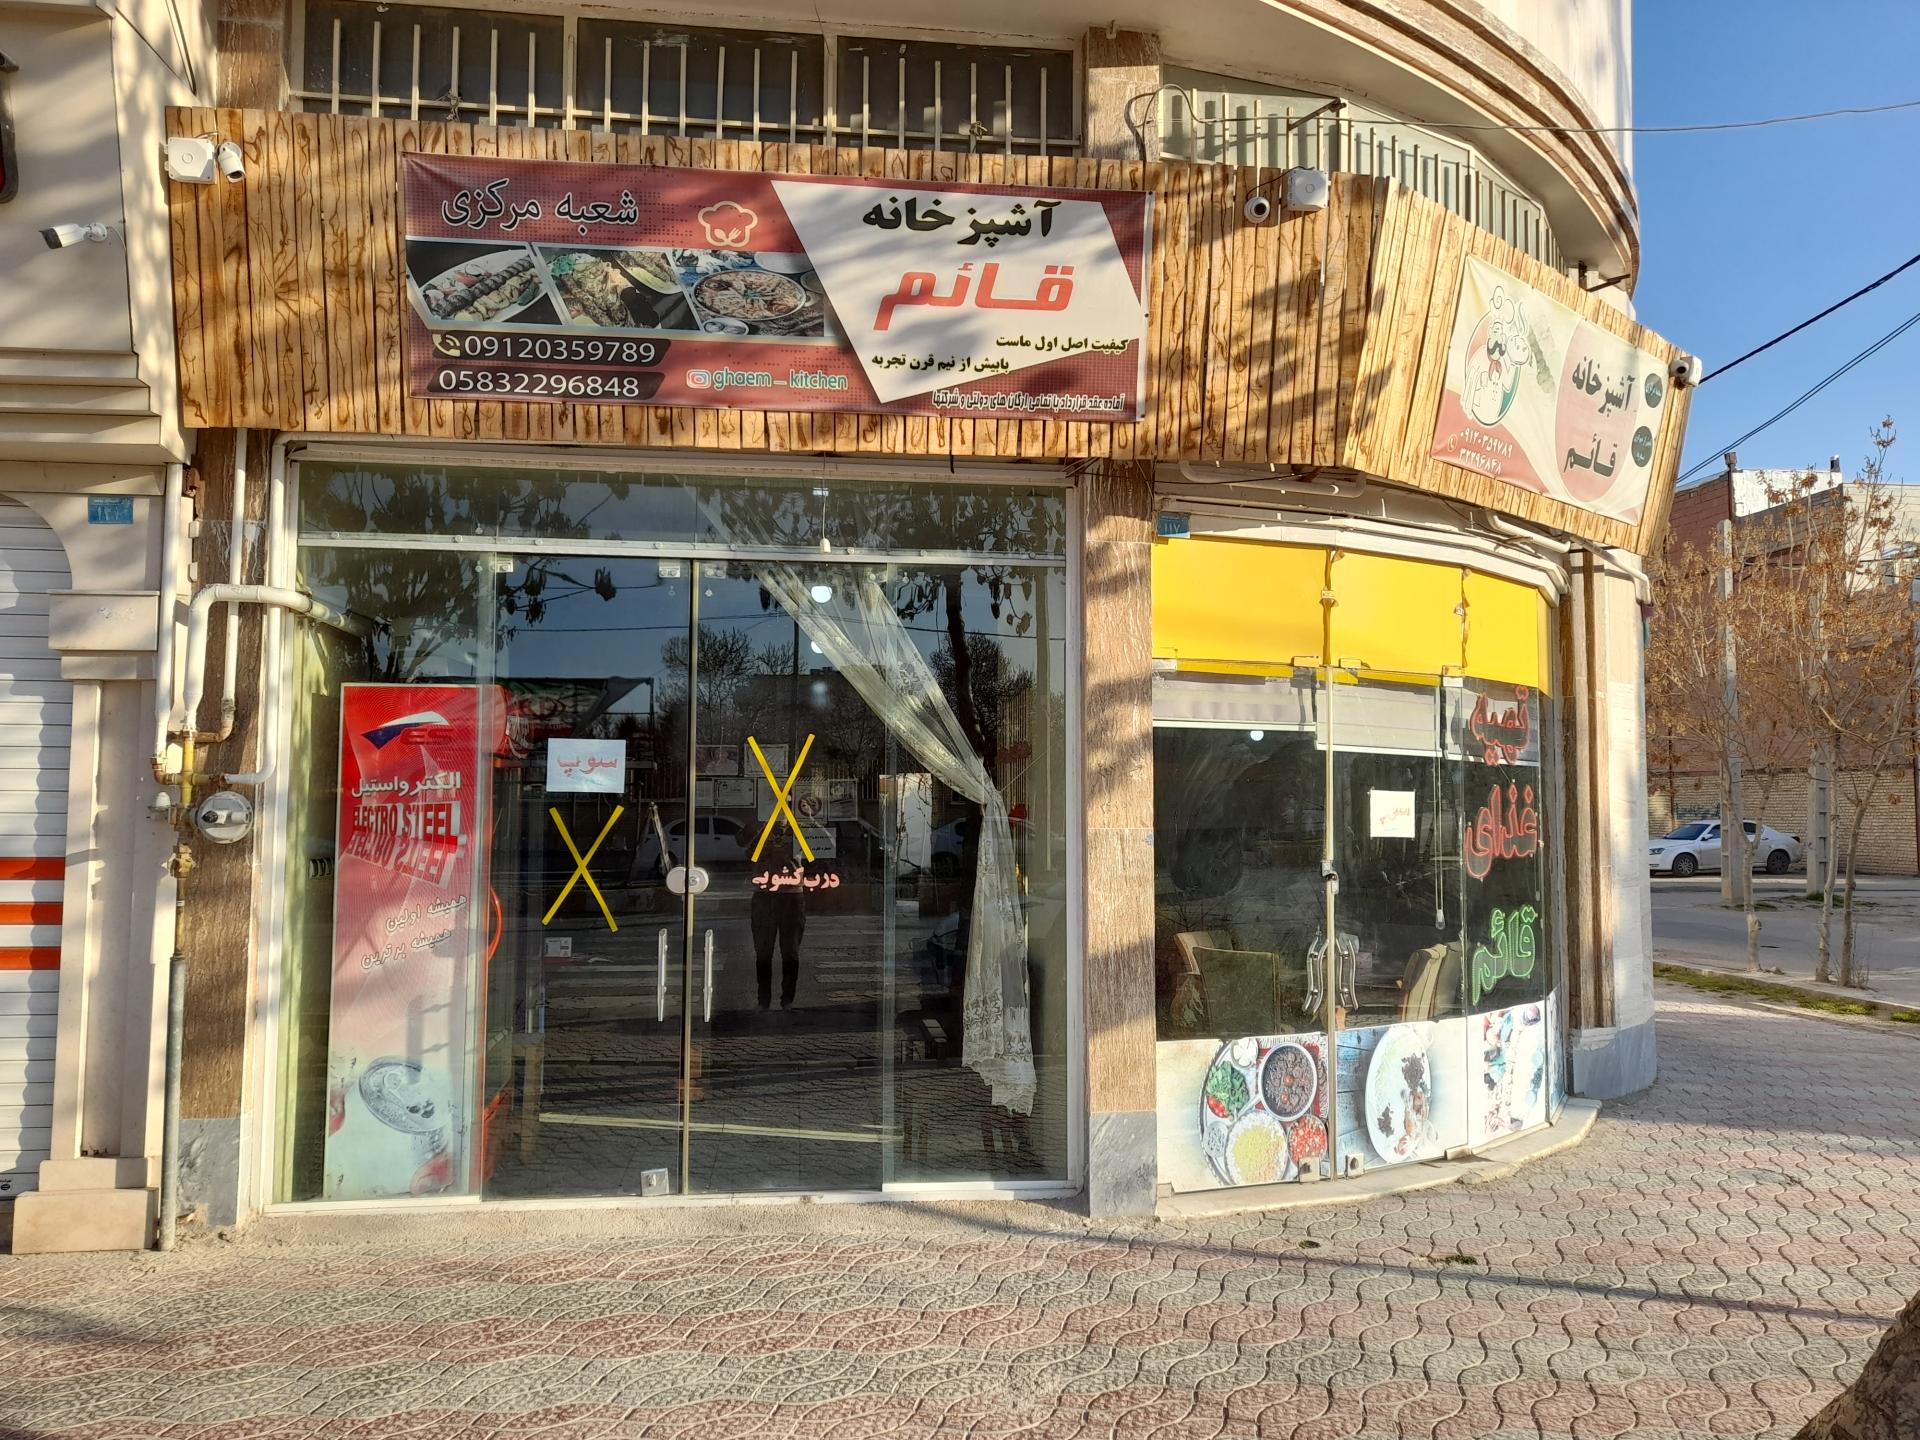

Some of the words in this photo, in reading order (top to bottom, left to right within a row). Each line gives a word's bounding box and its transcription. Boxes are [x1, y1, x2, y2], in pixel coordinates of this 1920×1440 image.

[441, 178, 542, 231] مرکزی
[555, 189, 639, 236] شعبه
[873, 262, 1075, 331] قائم
[464, 335, 656, 363] 09120359789
[996, 335, 1031, 348] ماست
[1035, 336, 1058, 351] اول
[1061, 338, 1088, 351] اصل
[1091, 338, 1129, 354] کیفیت
[871, 354, 906, 367] تجربه
[910, 353, 934, 370] قرن
[938, 355, 955, 371] نیم
[959, 356, 970, 371] از
[439, 369, 639, 397] 05832296848
[1563, 432, 1618, 477] قائم
[353, 803, 398, 836] ELECTRO
[404, 802, 458, 846] STEEL
[1463, 784, 1539, 879] غذای
[803, 873, 840, 892] درب
[427, 894, 467, 915] همیشه
[386, 904, 421, 931] اولین
[411, 929, 452, 948] همیشه
[1471, 905, 1537, 1005] قائم
